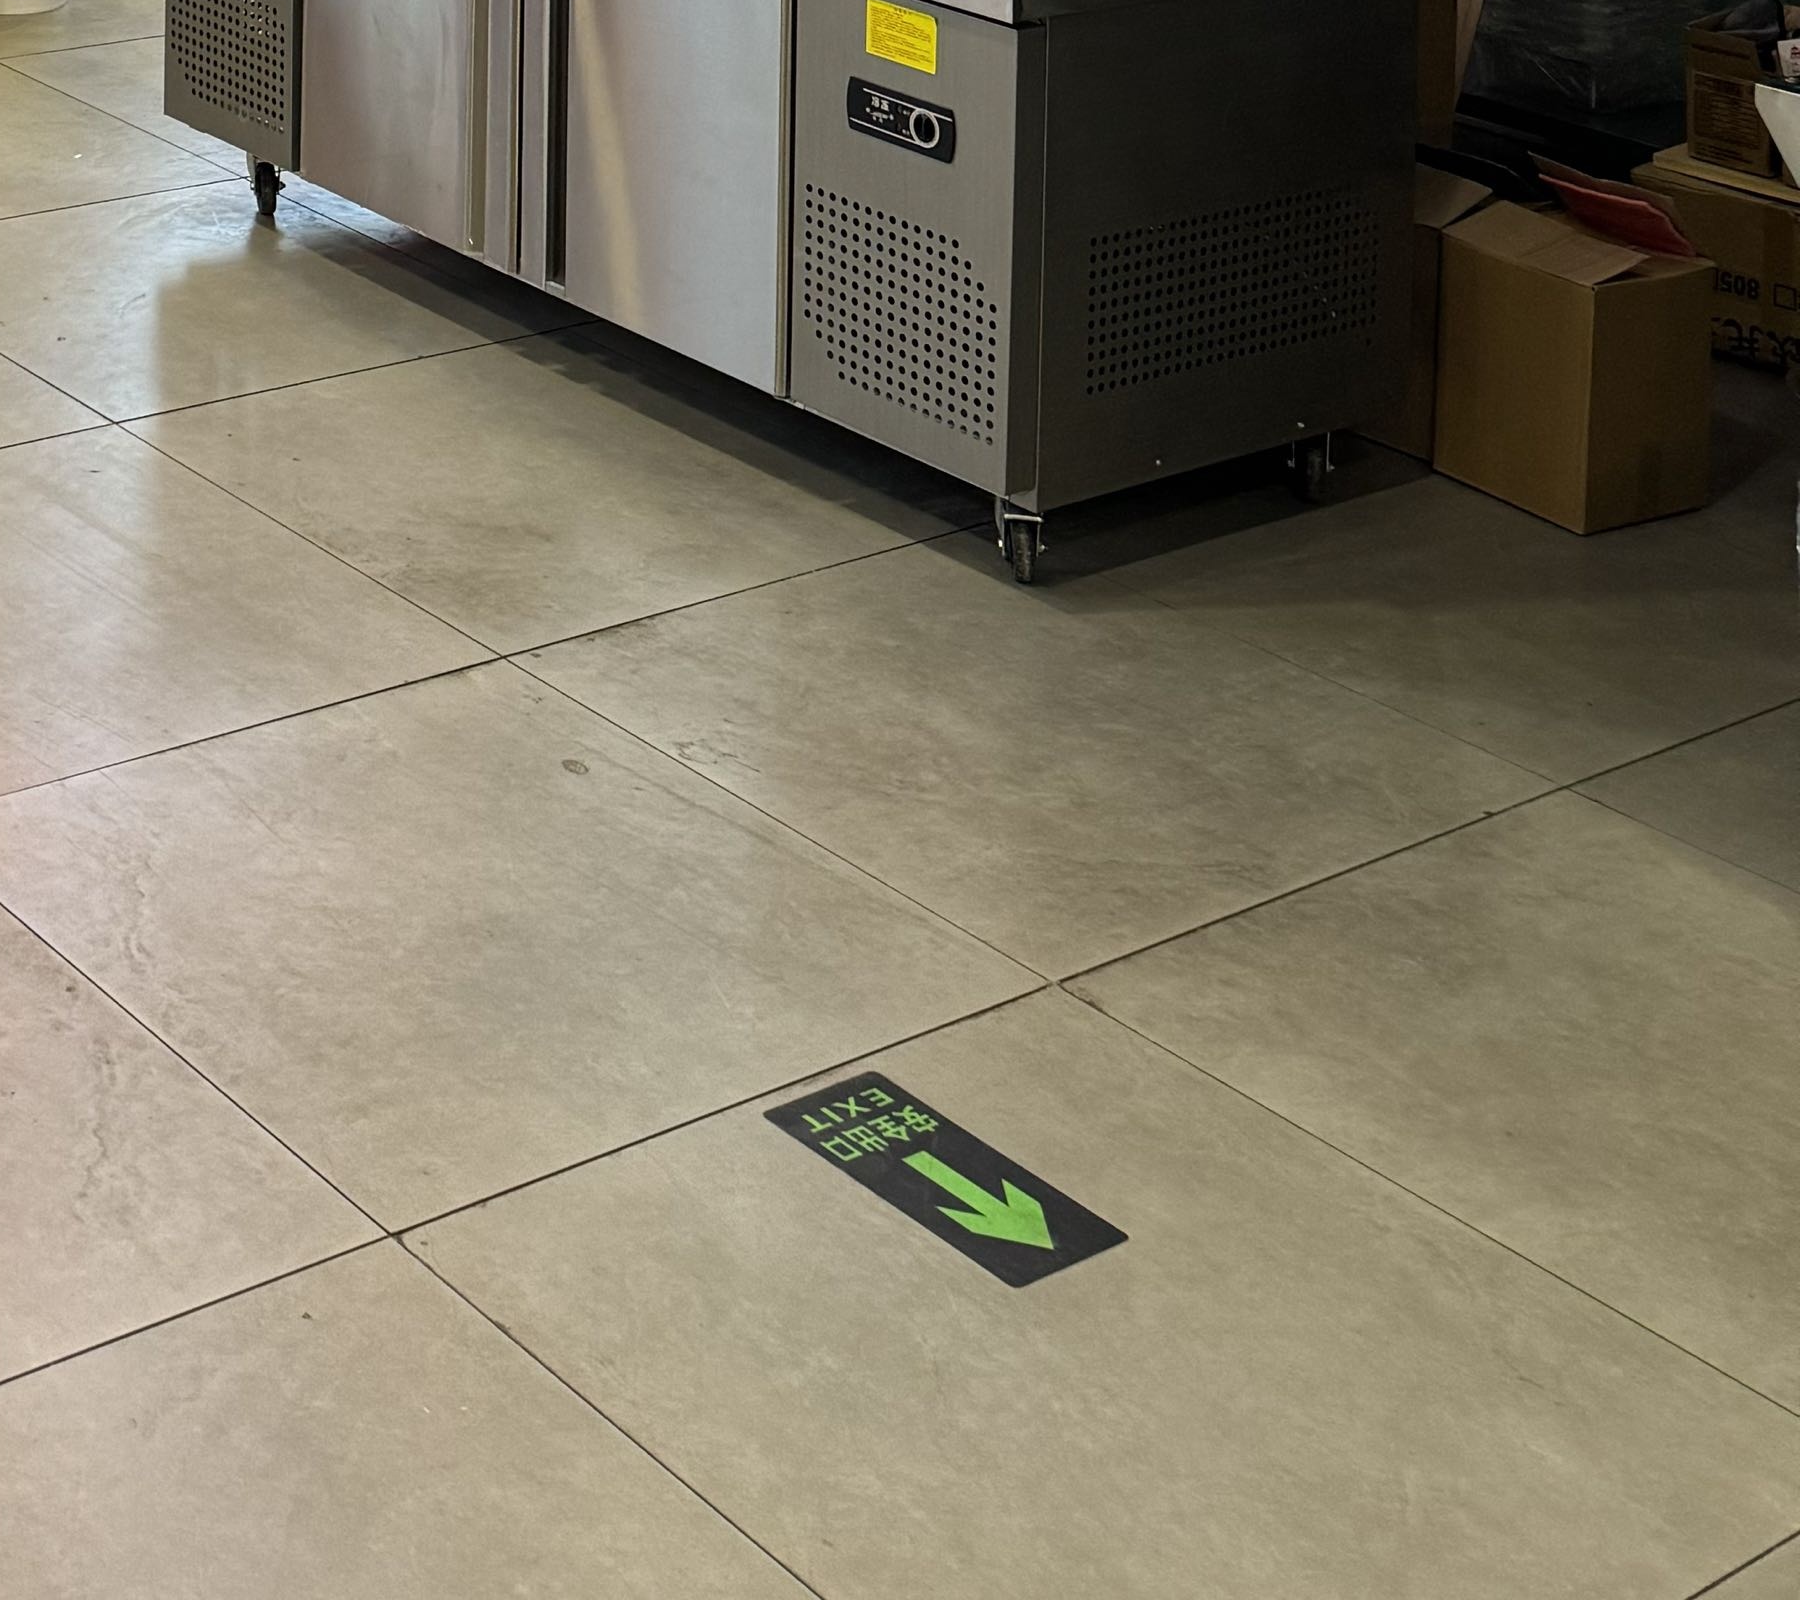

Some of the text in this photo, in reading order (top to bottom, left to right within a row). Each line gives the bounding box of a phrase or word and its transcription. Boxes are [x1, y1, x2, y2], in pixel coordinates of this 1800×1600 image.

[802, 1087, 894, 1133] EXIT
[820, 1105, 939, 1161] 安全出口
